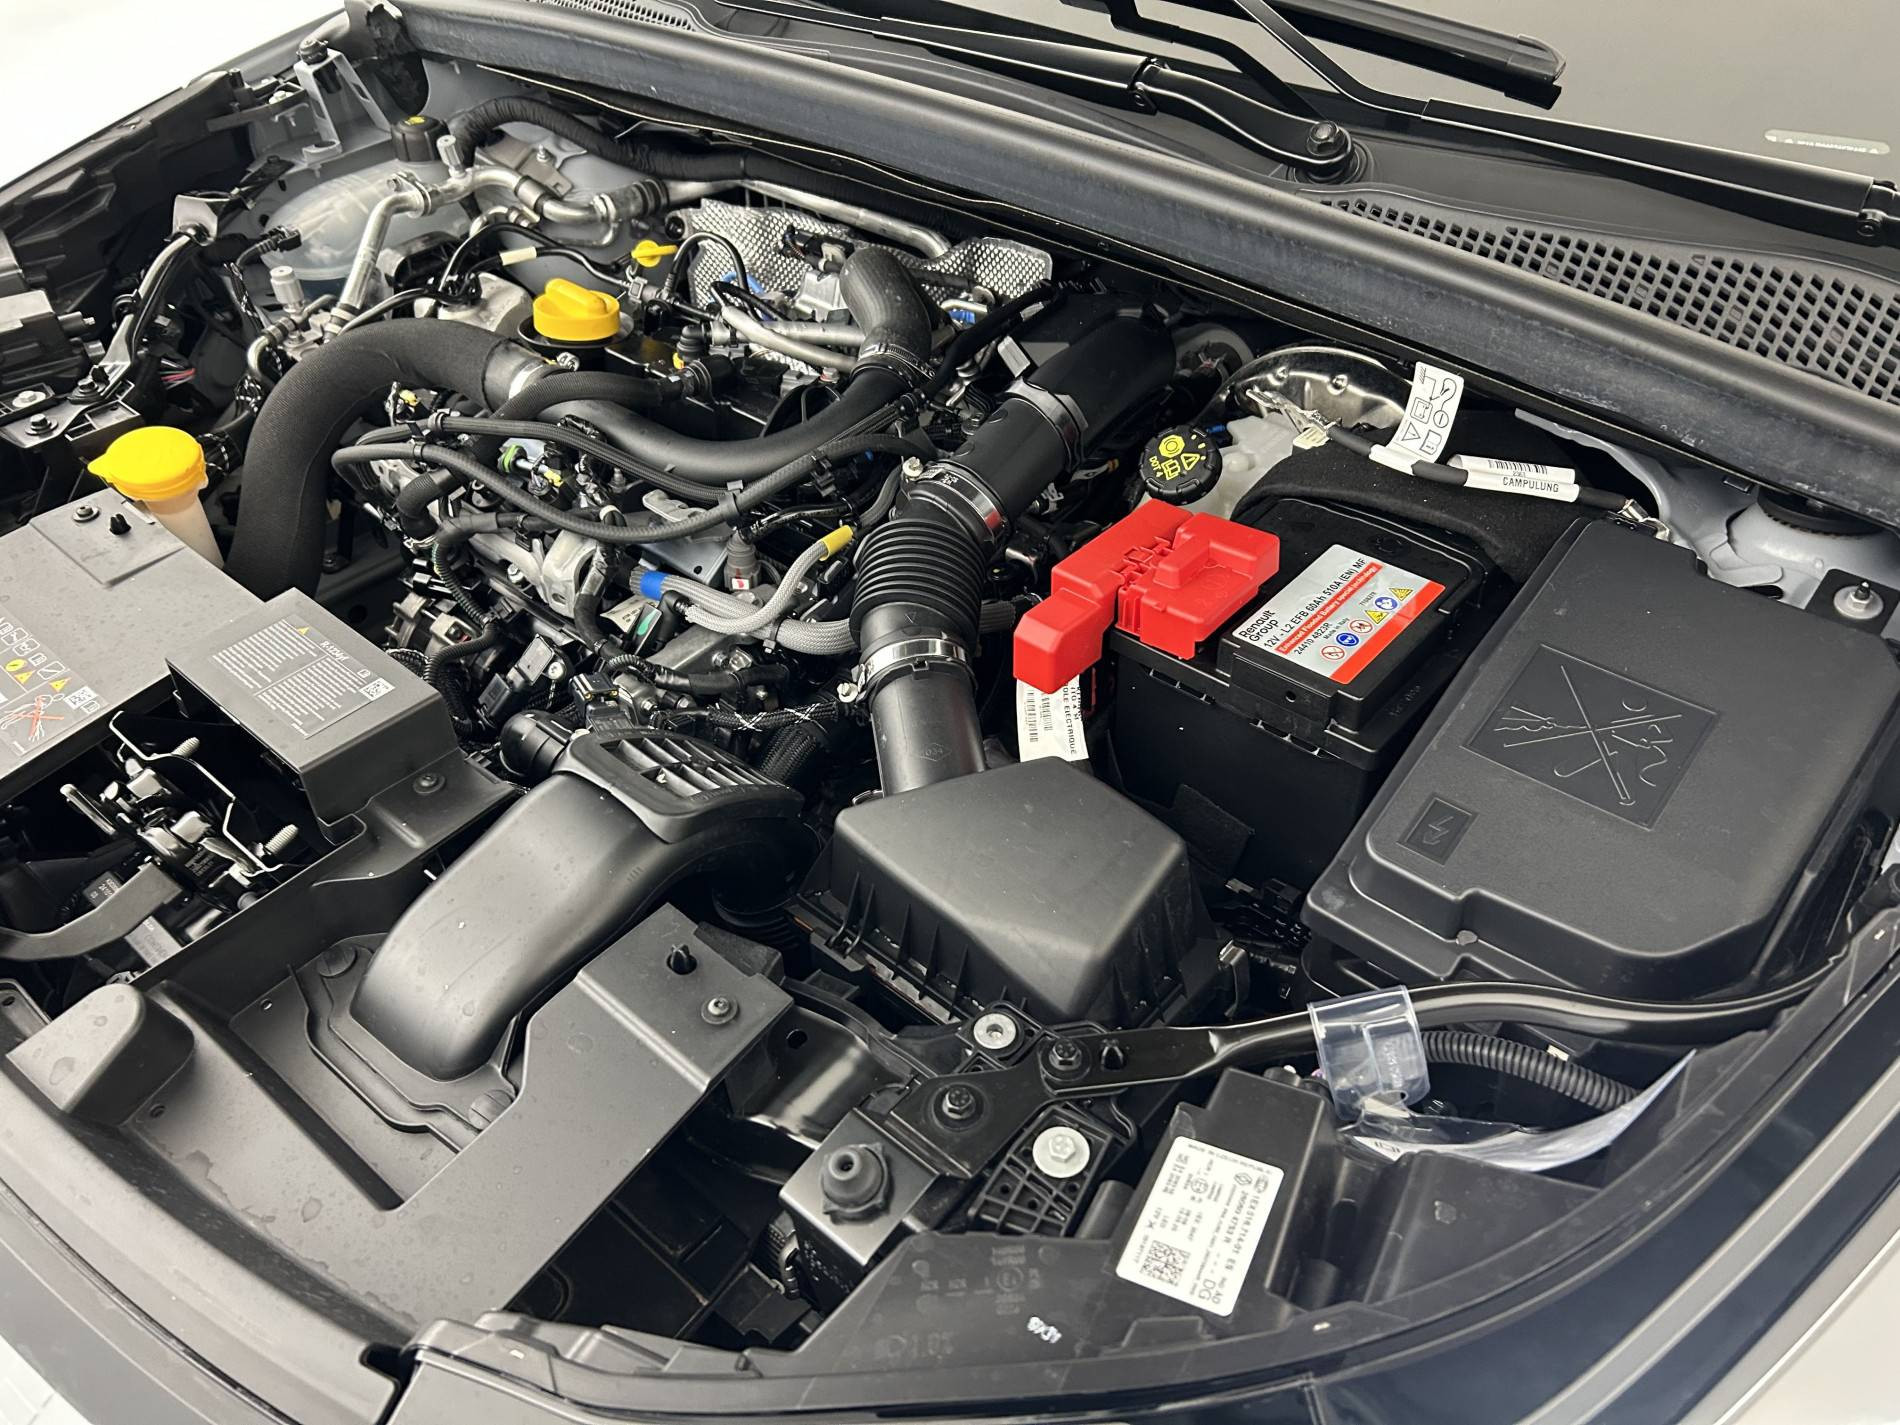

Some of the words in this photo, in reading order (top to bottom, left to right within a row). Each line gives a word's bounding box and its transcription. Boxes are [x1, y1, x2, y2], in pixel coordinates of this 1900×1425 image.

[1149, 455, 1161, 471] DOT
[1502, 476, 1559, 493] CAMPULUNG
[1263, 634, 1280, 649] 12V
[1282, 622, 1293, 634] L2
[1291, 610, 1309, 626] EFB
[1306, 593, 1329, 613] 60Ah
[1324, 580, 1343, 598] 510A
[1340, 568, 1359, 585] (EN)
[1352, 558, 1367, 571] MF
[1238, 610, 1276, 638] Renault
[1248, 618, 1280, 643] Group
[1198, 1278, 1217, 1301] DG
